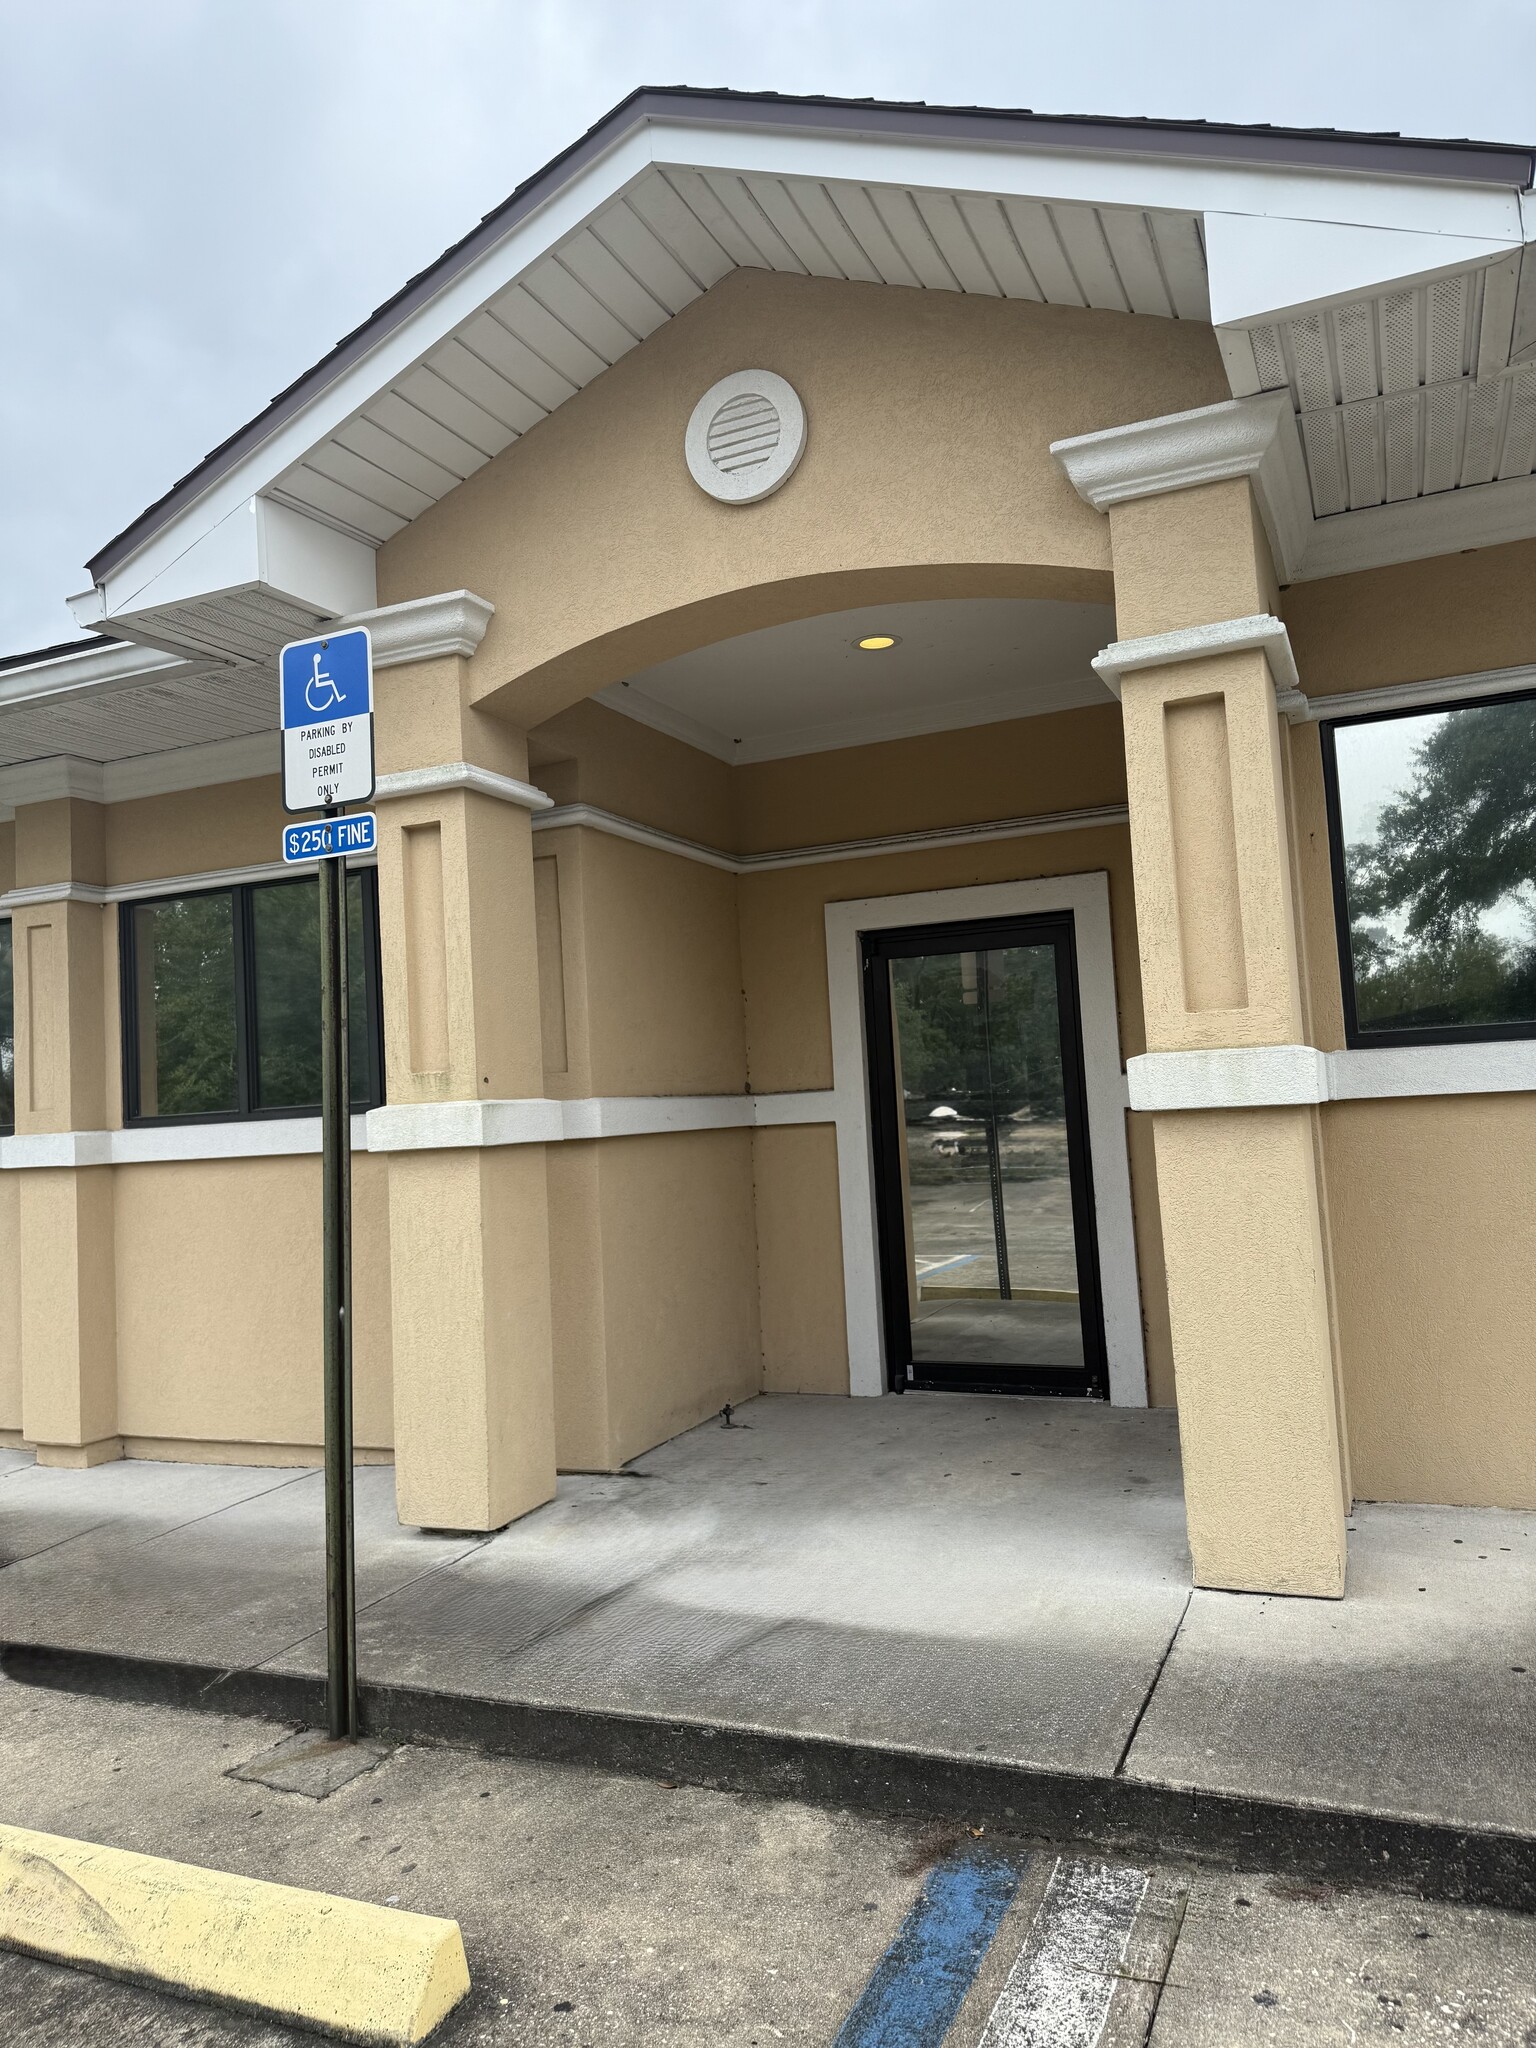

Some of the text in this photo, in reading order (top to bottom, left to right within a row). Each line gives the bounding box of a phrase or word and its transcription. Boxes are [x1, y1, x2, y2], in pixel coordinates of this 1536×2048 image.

[300, 721, 353, 742] PARKING BY
[309, 742, 346, 759] DISABLED
[312, 762, 344, 778] PERMIT
[317, 783, 340, 797] ONLY
[289, 821, 371, 855] $250 FINE
